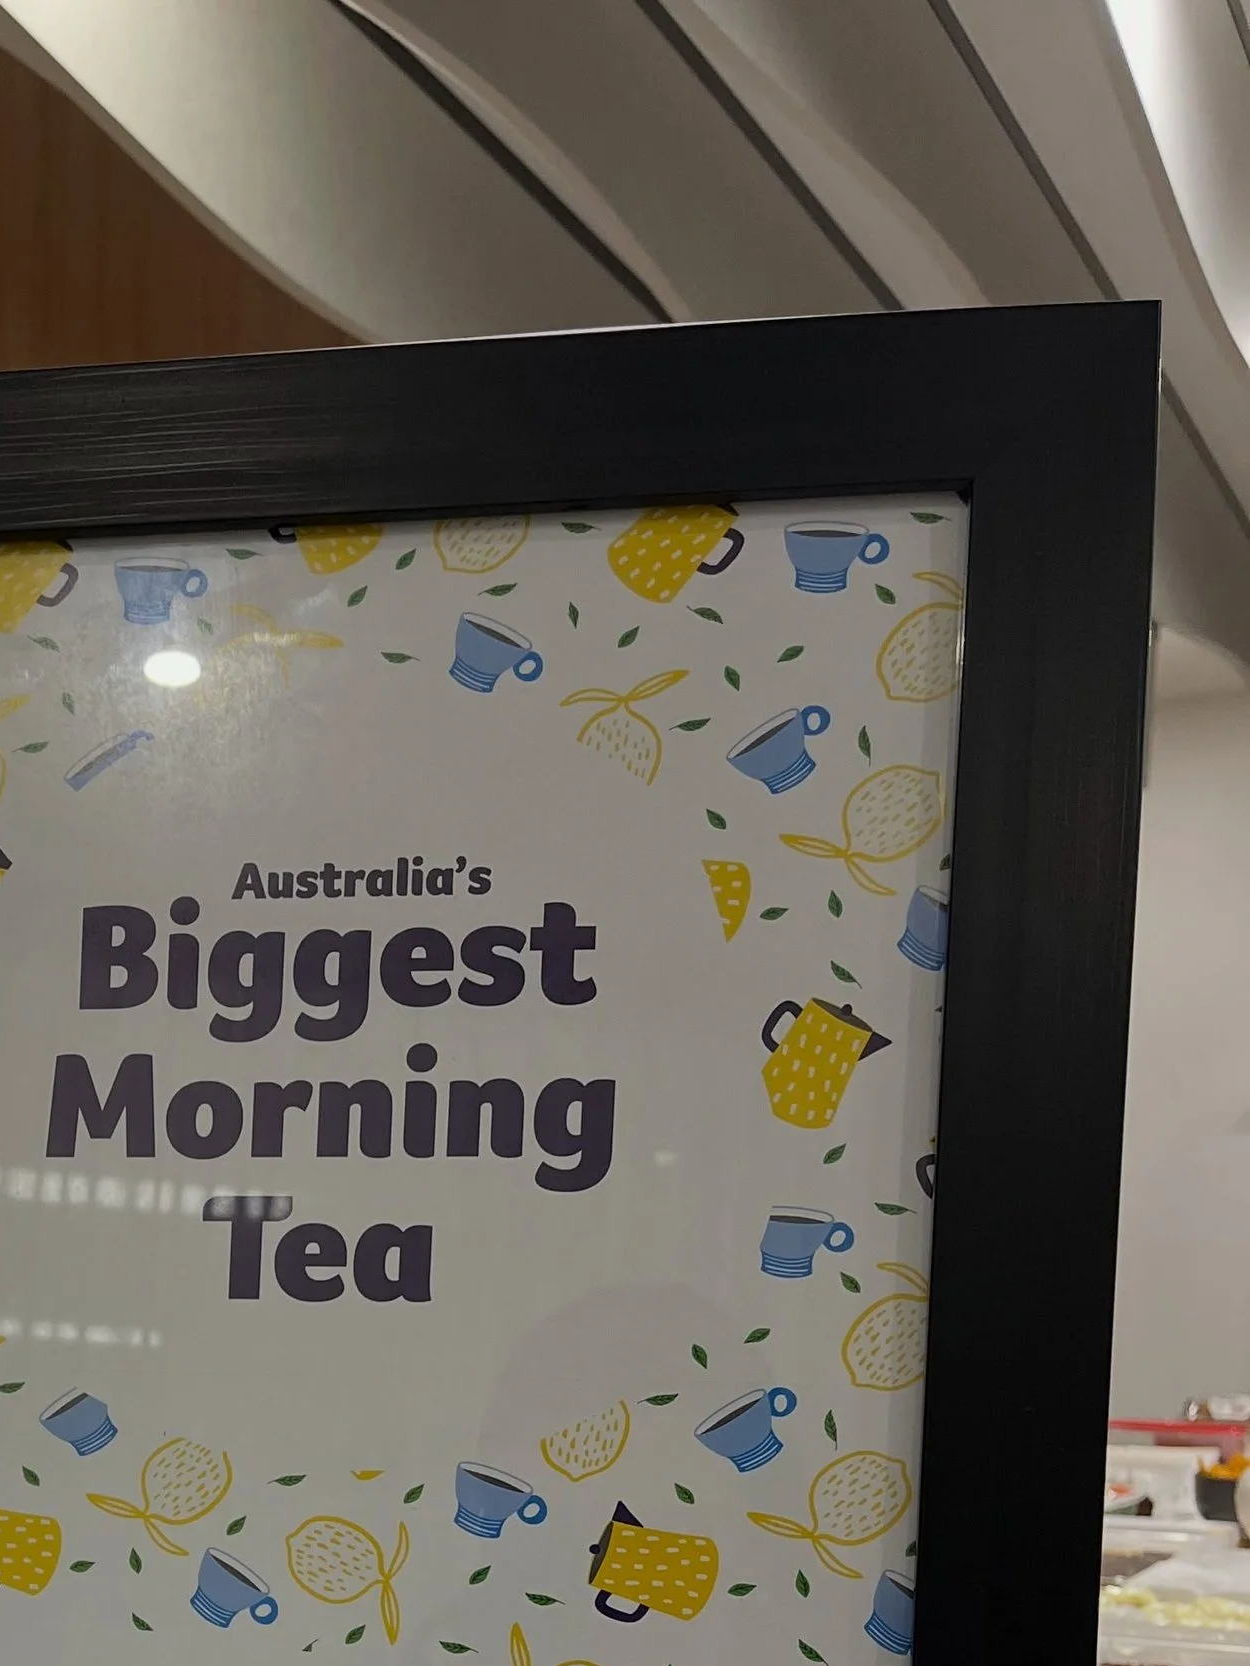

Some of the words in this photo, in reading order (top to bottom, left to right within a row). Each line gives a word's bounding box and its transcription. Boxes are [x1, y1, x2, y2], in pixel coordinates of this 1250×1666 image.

[231, 856, 492, 900] Australia's
[79, 896, 597, 1043] Biggest
[46, 1042, 616, 1193] Morning
[202, 1195, 433, 1302] Tea
